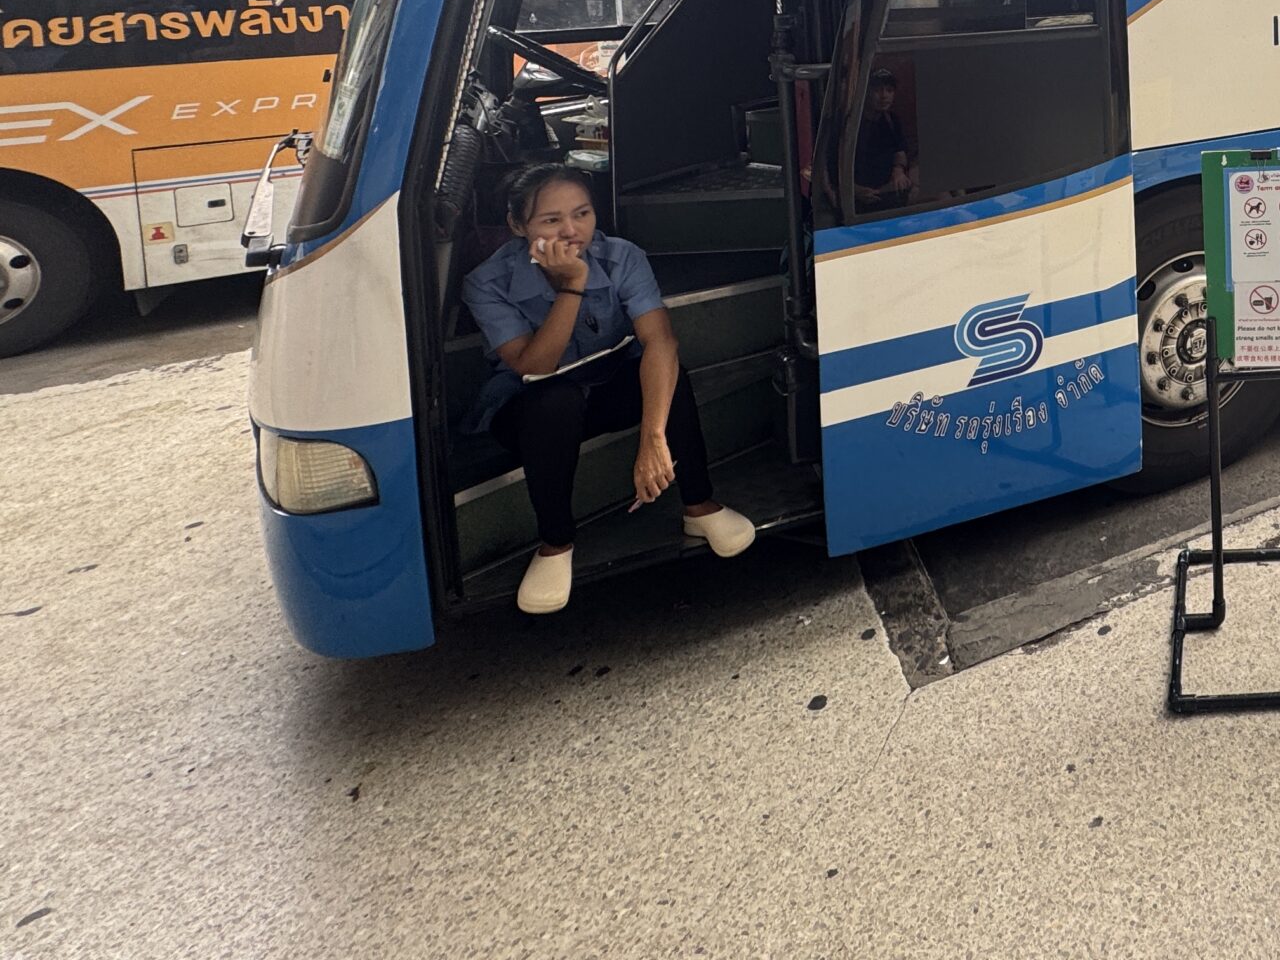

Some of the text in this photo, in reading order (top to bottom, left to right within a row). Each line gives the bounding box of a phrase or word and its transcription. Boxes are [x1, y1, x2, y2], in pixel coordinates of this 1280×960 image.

[1256, 184, 1273, 192] Term
[1237, 324, 1256, 332] Please
[886, 391, 951, 437] บริษัท
[1054, 358, 1105, 409] จำกัด
